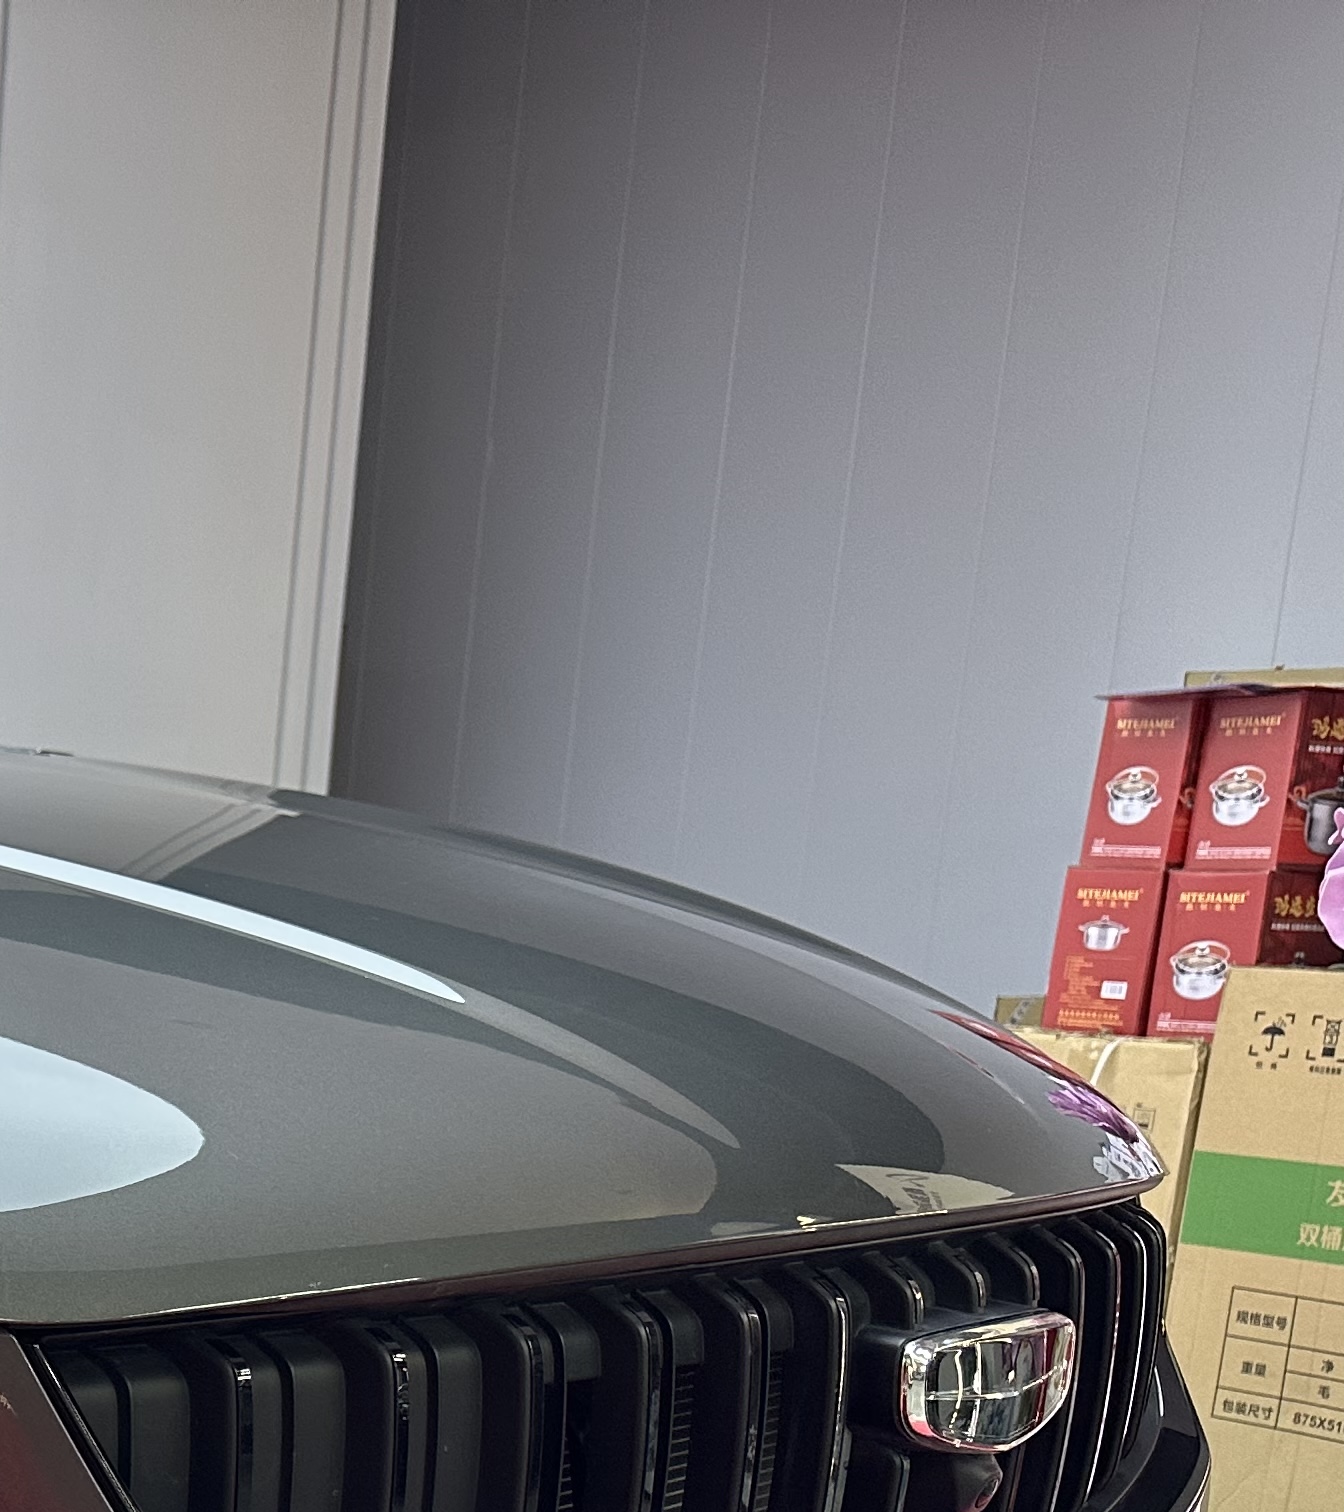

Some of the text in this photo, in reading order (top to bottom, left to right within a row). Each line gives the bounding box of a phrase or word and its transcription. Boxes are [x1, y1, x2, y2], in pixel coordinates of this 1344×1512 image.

[1296, 1222, 1344, 1252] 双桶
[1222, 1397, 1274, 1421] 包装尺寸
[1293, 1411, 1344, 1434] 875X51
